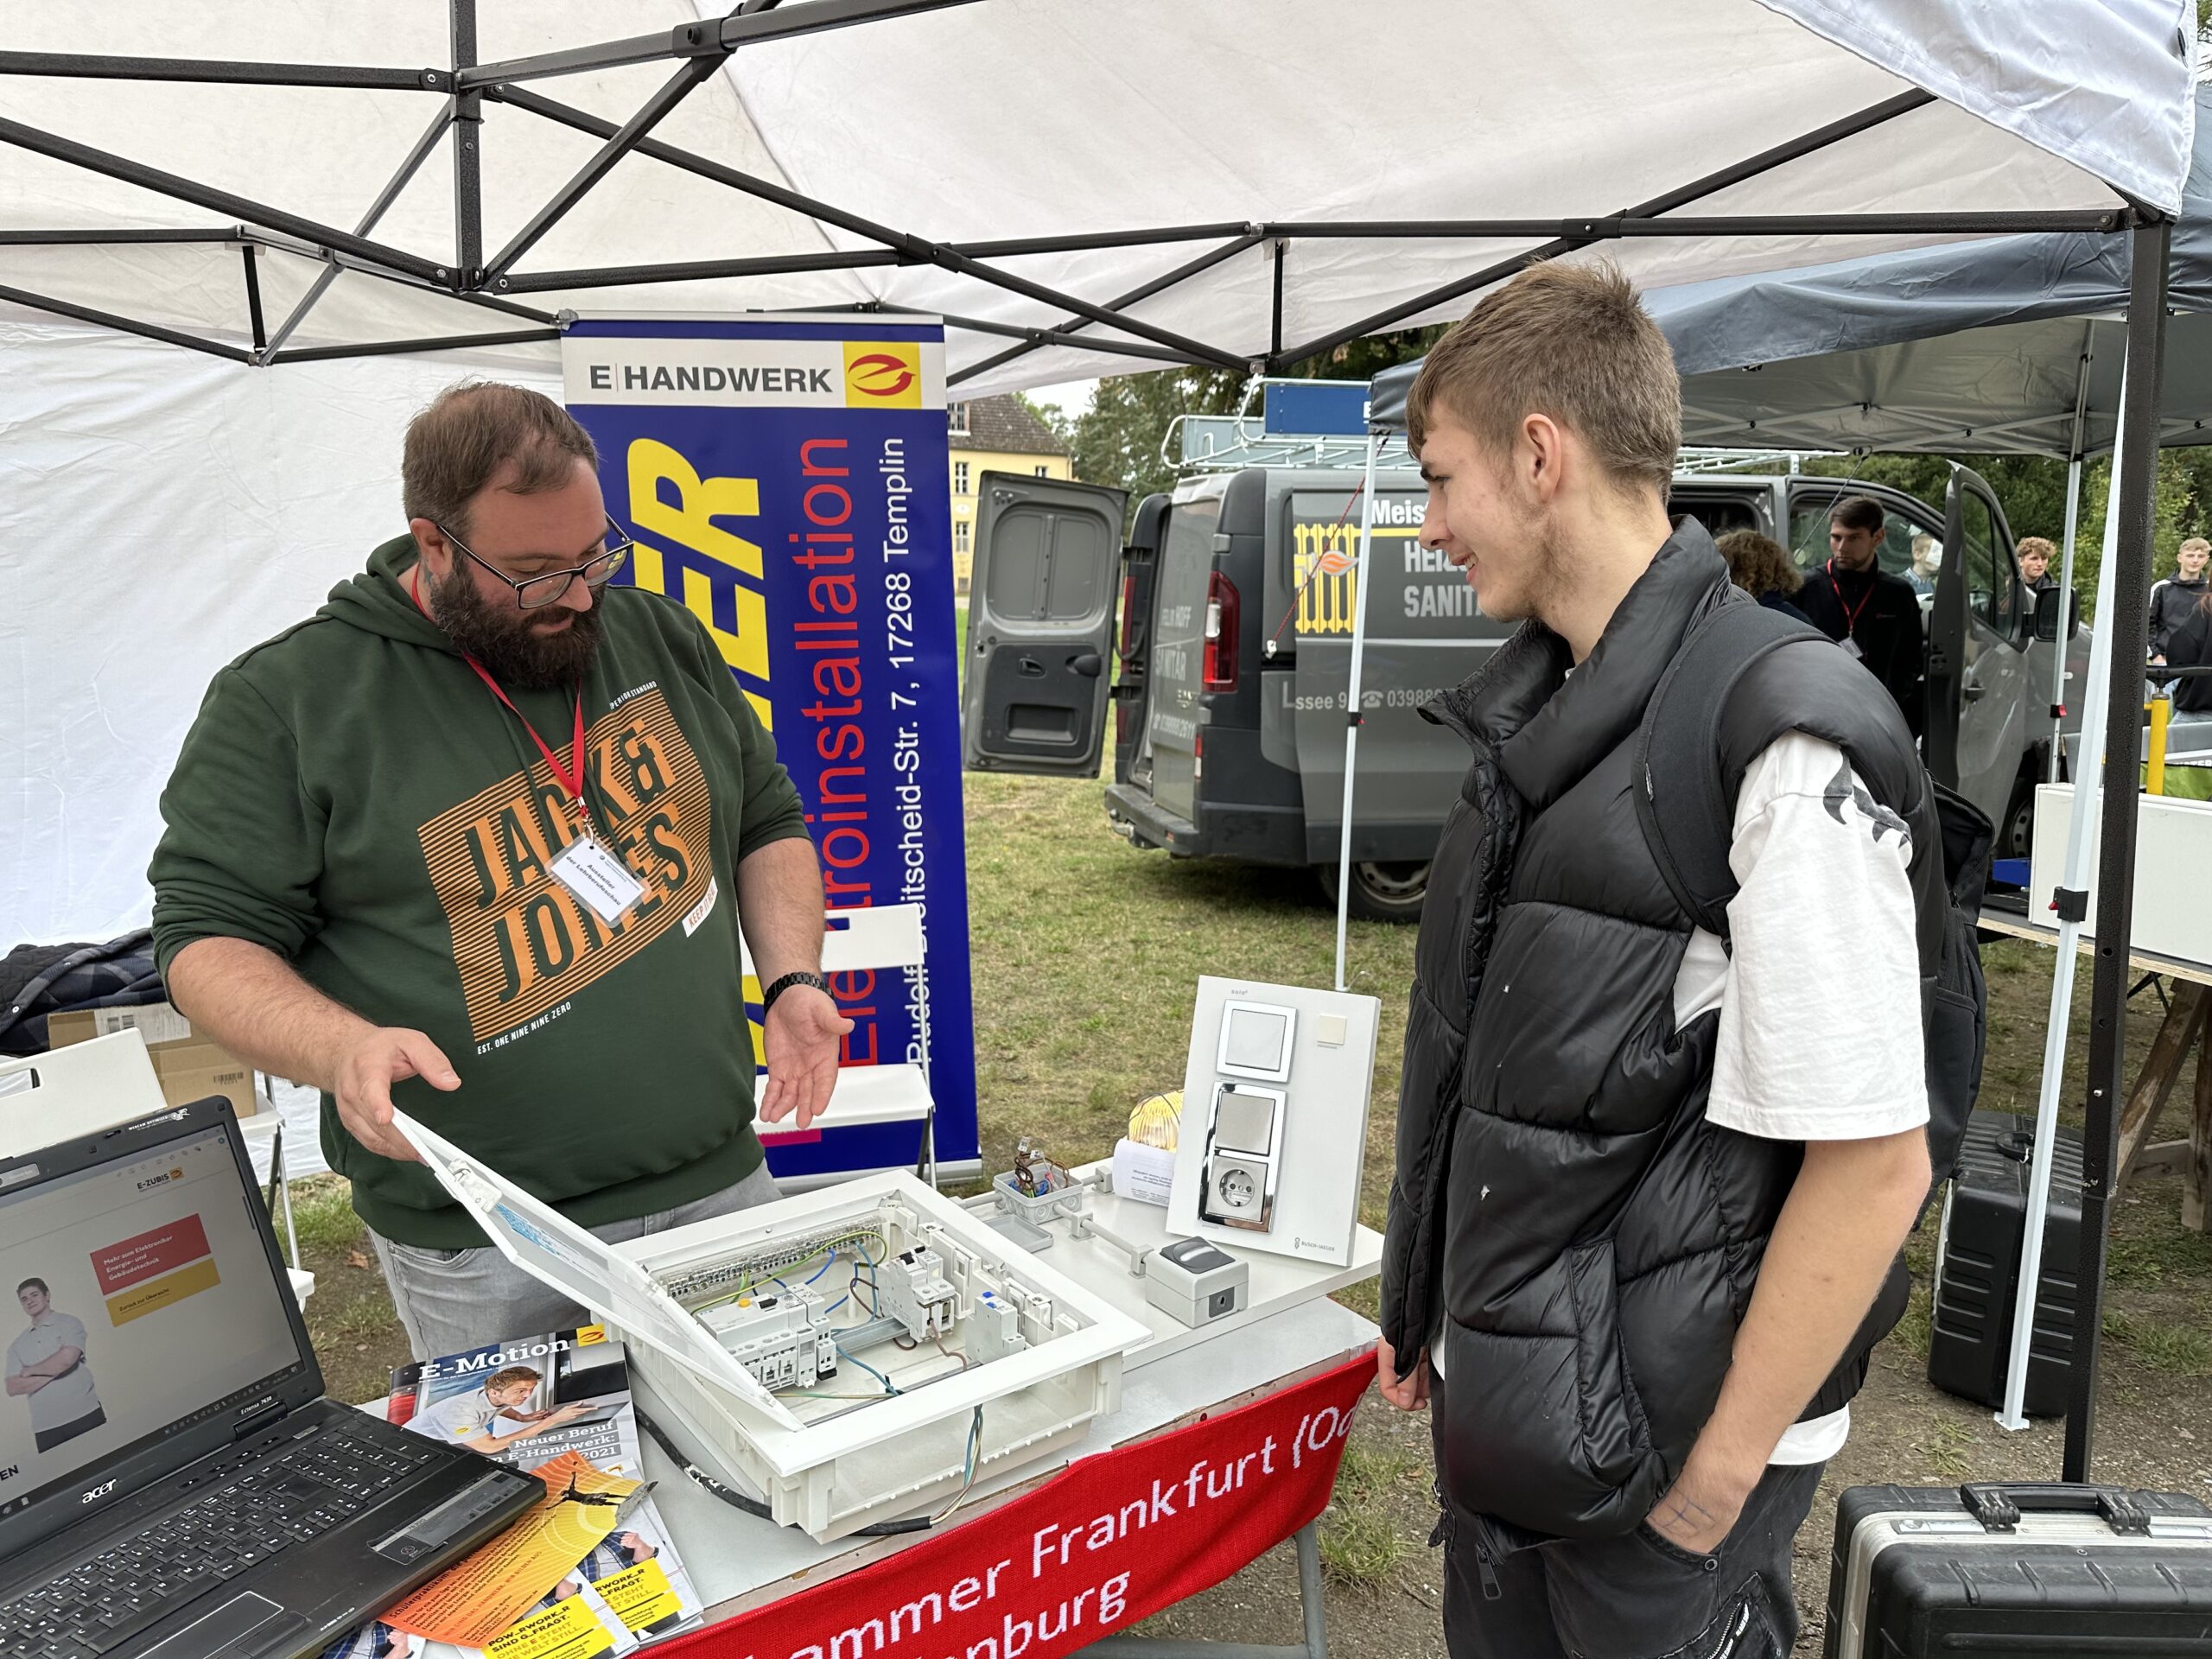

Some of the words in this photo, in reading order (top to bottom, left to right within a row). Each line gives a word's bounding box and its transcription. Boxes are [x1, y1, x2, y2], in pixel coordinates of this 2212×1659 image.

[589, 365, 612, 390] E
[623, 365, 833, 393] HANDWERK
[879, 437, 912, 563] Templin
[1371, 499, 1429, 525] Meis
[1403, 540, 1468, 574] HEI
[1403, 584, 1483, 618] SANIT
[884, 572, 914, 669] 17268
[1387, 689, 1457, 708] 03988
[787, 438, 879, 1067] Eletroinstallation
[566, 855, 577, 866] der
[587, 864, 615, 890] Aussteller
[892, 721, 933, 1064] Rudolfitscheid-Str.
[493, 809, 691, 1004] JOES
[477, 1042, 493, 1055] EST.
[494, 1034, 510, 1048] ONE
[511, 1025, 530, 1041] NINE
[531, 1014, 550, 1031] NINE
[550, 1001, 572, 1020] ZERO
[137, 1173, 169, 1191] E-ZUBIS
[103, 1254, 121, 1266] Mehr
[135, 1236, 173, 1254] Elektroniker
[105, 1259, 134, 1273] Energie-
[135, 1254, 148, 1262] und
[108, 1257, 160, 1281] Gebäudetechnik
[418, 1338, 571, 1381] E-Motion
[507, 1433, 616, 1461] E-Handwerk:
[514, 1433, 565, 1449] Neuer
[568, 1420, 613, 1440] Beruf
[582, 1446, 617, 1459] 2021
[81, 1478, 118, 1506] acer
[748, 1558, 1012, 1659] mmer
[1033, 1434, 1277, 1579] Frankfurt
[612, 1584, 645, 1601] STEHT
[487, 1605, 571, 1647] POW_RWORK_R
[918, 1570, 1131, 1659] nburg
[492, 1638, 518, 1653] SIND
[520, 1615, 571, 1640] G_FRAGT.
[497, 1642, 529, 1659] OHNE
[537, 1620, 572, 1641] STEHT
[520, 1640, 550, 1656] WELT
[551, 1625, 584, 1643] STILL.
